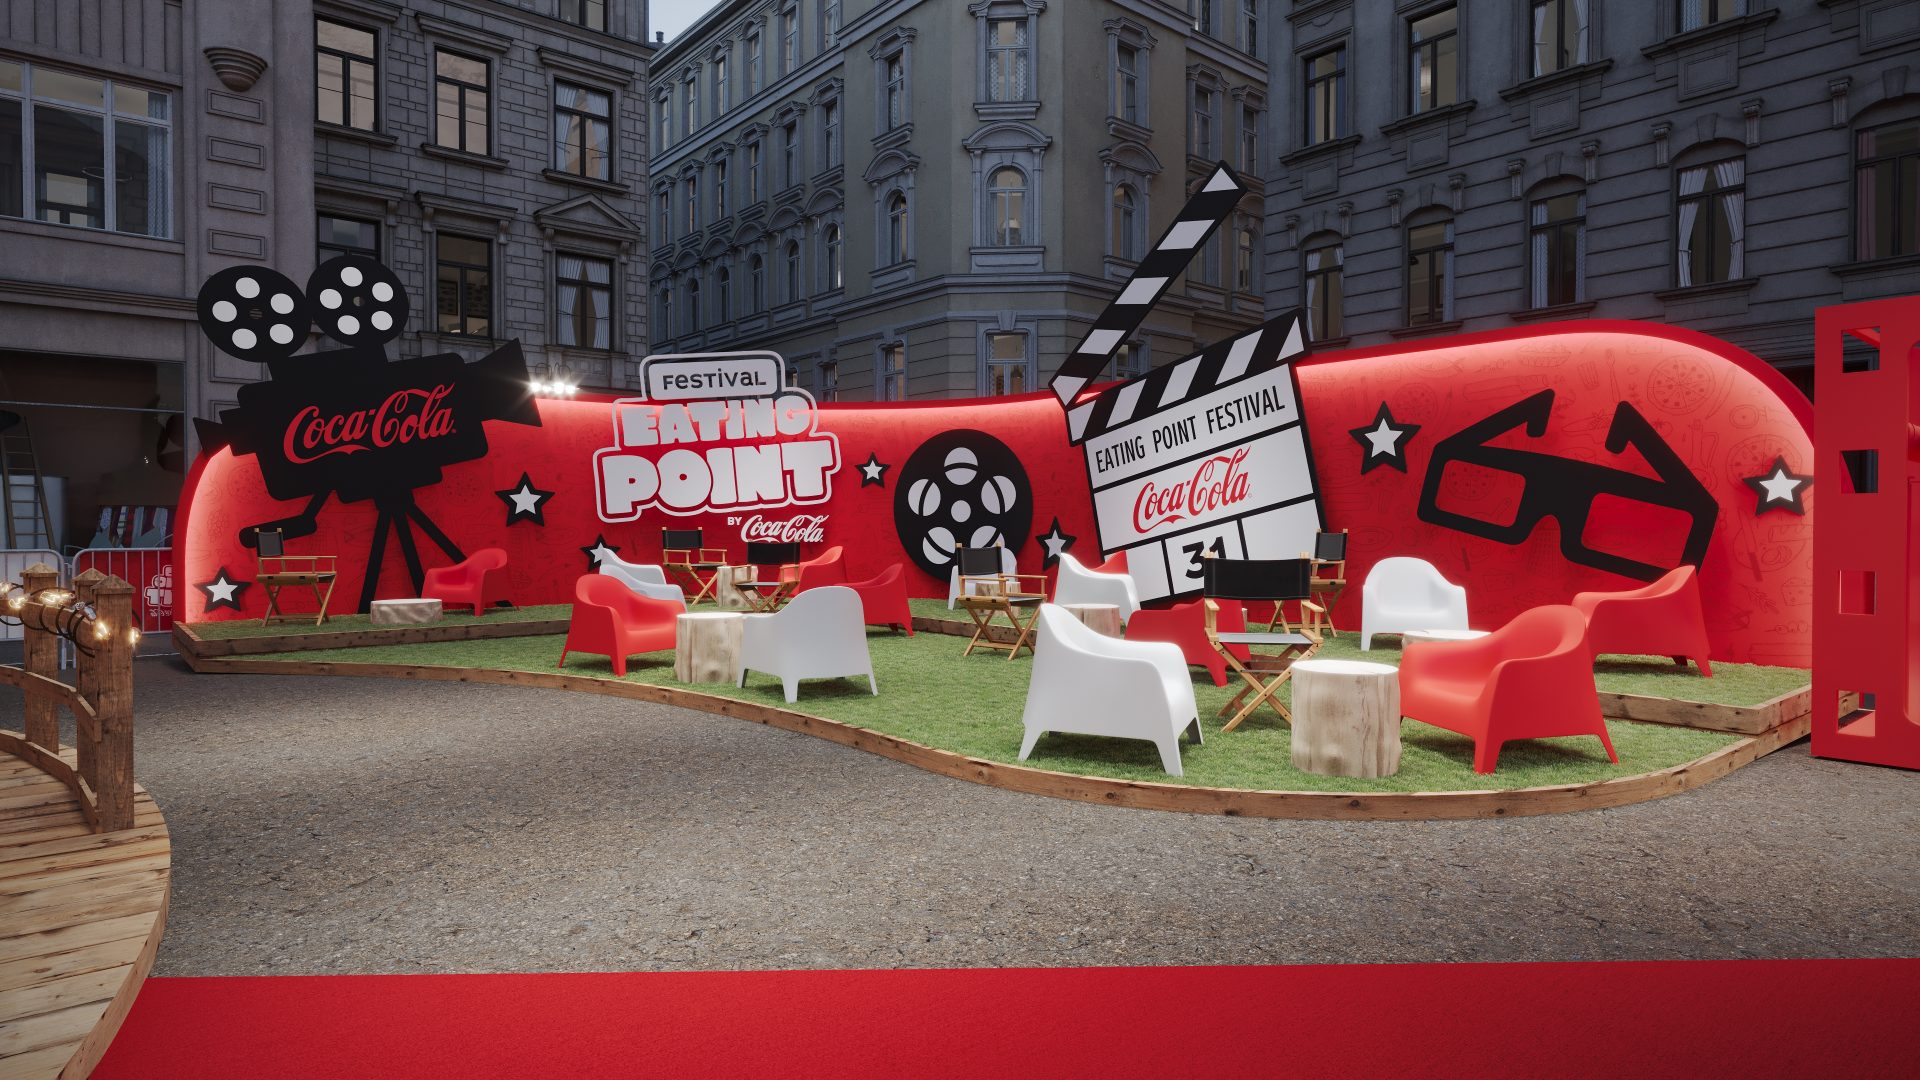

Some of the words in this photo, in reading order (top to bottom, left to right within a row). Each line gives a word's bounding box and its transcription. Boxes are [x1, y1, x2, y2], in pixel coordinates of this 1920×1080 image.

[283, 382, 457, 464] Coca-Cola
[621, 395, 811, 447] EATING
[1095, 435, 1145, 473] EATING
[1152, 415, 1197, 453] POINT
[1206, 385, 1285, 434] FESTIVAL
[602, 440, 834, 515] POINT
[1132, 445, 1252, 534] Coca-Cola
[727, 516, 742, 526] BY
[740, 514, 830, 543] Coca-Cola
